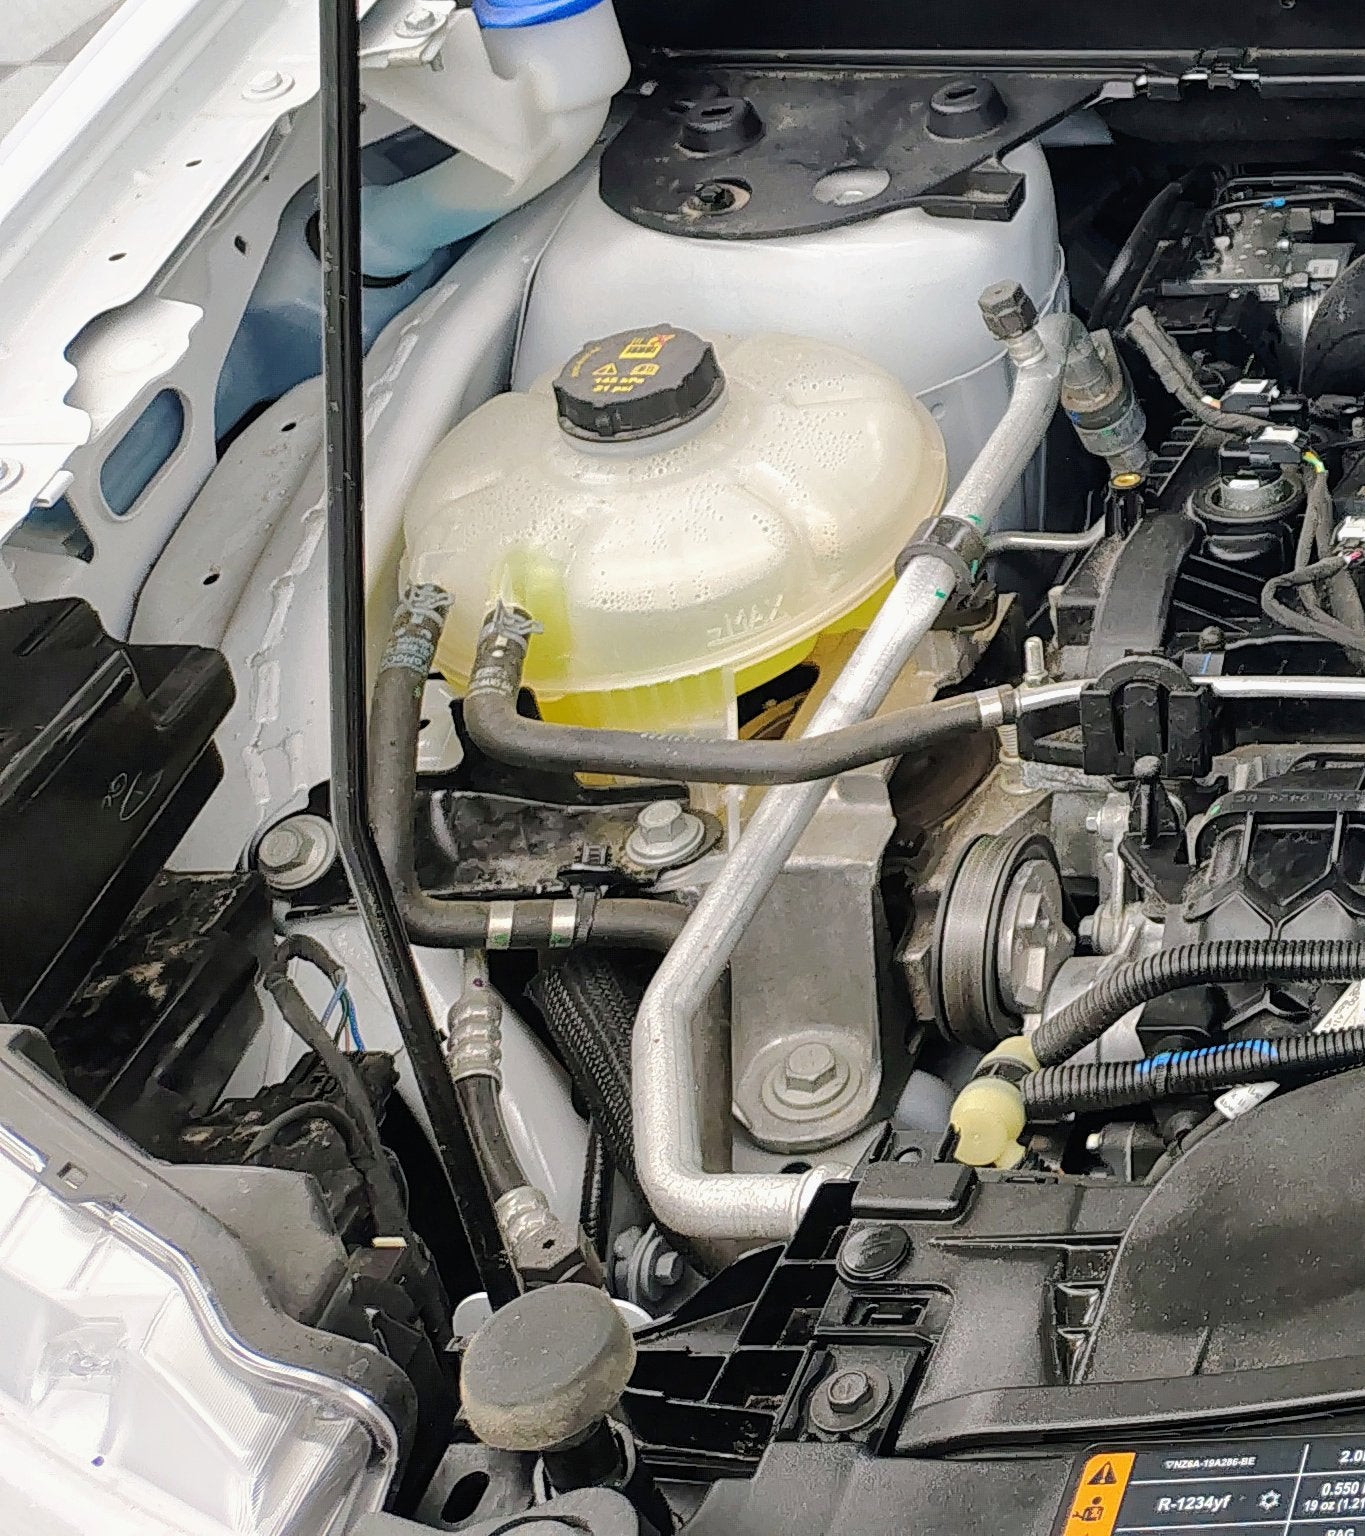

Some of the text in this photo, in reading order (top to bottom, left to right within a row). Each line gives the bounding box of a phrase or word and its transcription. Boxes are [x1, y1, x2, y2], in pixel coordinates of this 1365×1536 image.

[1321, 1482, 1360, 1497] 0.550
[1156, 1494, 1233, 1513] R-1234yf
[1304, 1500, 1318, 1512] 19
[1319, 1501, 1335, 1511] oz
[1336, 1498, 1365, 1512] (1.21
